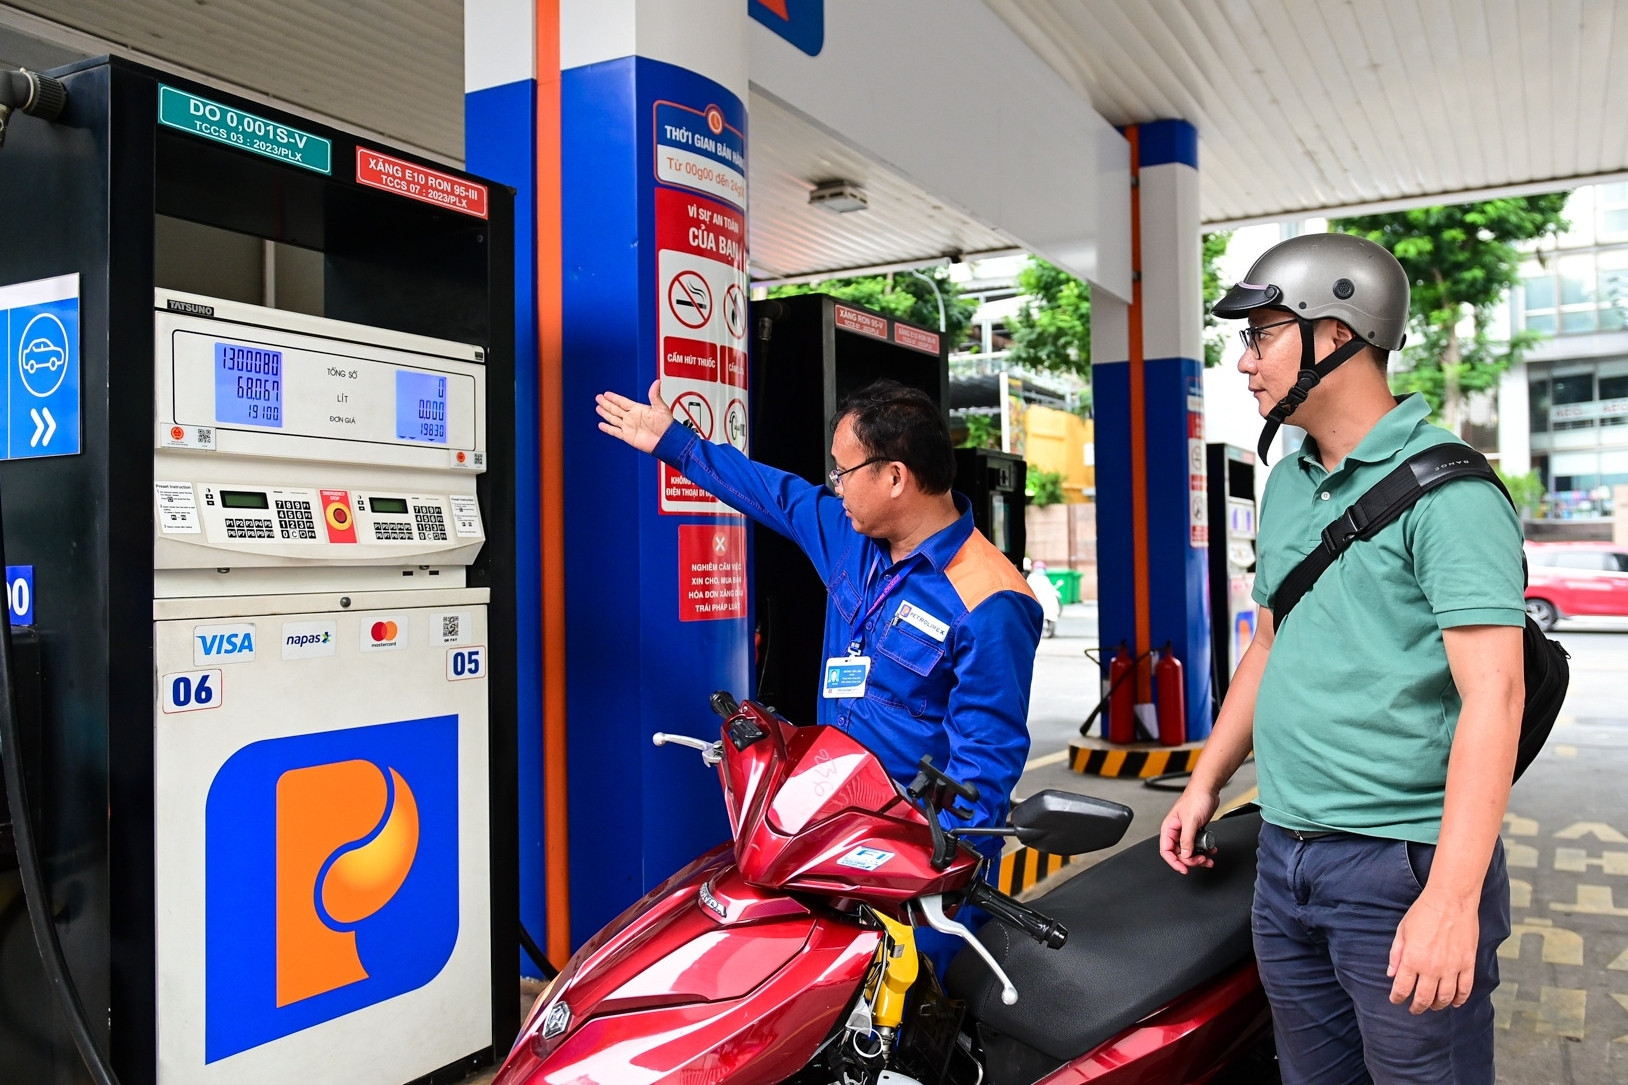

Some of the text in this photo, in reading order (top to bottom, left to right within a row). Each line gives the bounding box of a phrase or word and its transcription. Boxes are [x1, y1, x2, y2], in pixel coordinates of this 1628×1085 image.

[190, 98, 307, 148] DO 0,001S-V
[194, 121, 227, 138] TCCS
[231, 132, 243, 143] 03
[254, 140, 302, 162] 2023/PLX
[665, 125, 692, 144] THỜI
[695, 134, 715, 153] GIAN
[717, 143, 731, 161] BÁN
[369, 158, 477, 200] XĂNG E10 RON 95-III
[667, 157, 682, 171] Từ
[686, 161, 713, 181] 00g00
[716, 173, 729, 186] đến
[381, 176, 407, 190] TCCS
[410, 185, 420, 193] 07
[428, 190, 467, 208] 2023/PLX
[688, 204, 739, 232] VÌ SỰ AN TOÀN
[689, 224, 740, 261] CỦA BẠN
[170, 301, 212, 315] TATSUNO
[223, 347, 278, 376] 1300080
[668, 352, 716, 368] CẤM HÚT THUỐC
[327, 367, 357, 379] TỔNG SỐ
[337, 393, 348, 403] LÍT
[439, 379, 443, 397] 0
[421, 423, 444, 437] 19830
[666, 486, 680, 497] ĐIỆN
[682, 488, 698, 497] THOẠI
[692, 562, 717, 571] NGHIÊM
[6, 578, 29, 616] 0
[695, 603, 710, 612] TRÁI
[909, 612, 945, 636] PETROLIMEX
[196, 632, 253, 655] VISA
[286, 632, 320, 647] napas
[453, 650, 480, 676] 05
[172, 674, 212, 707] 06
